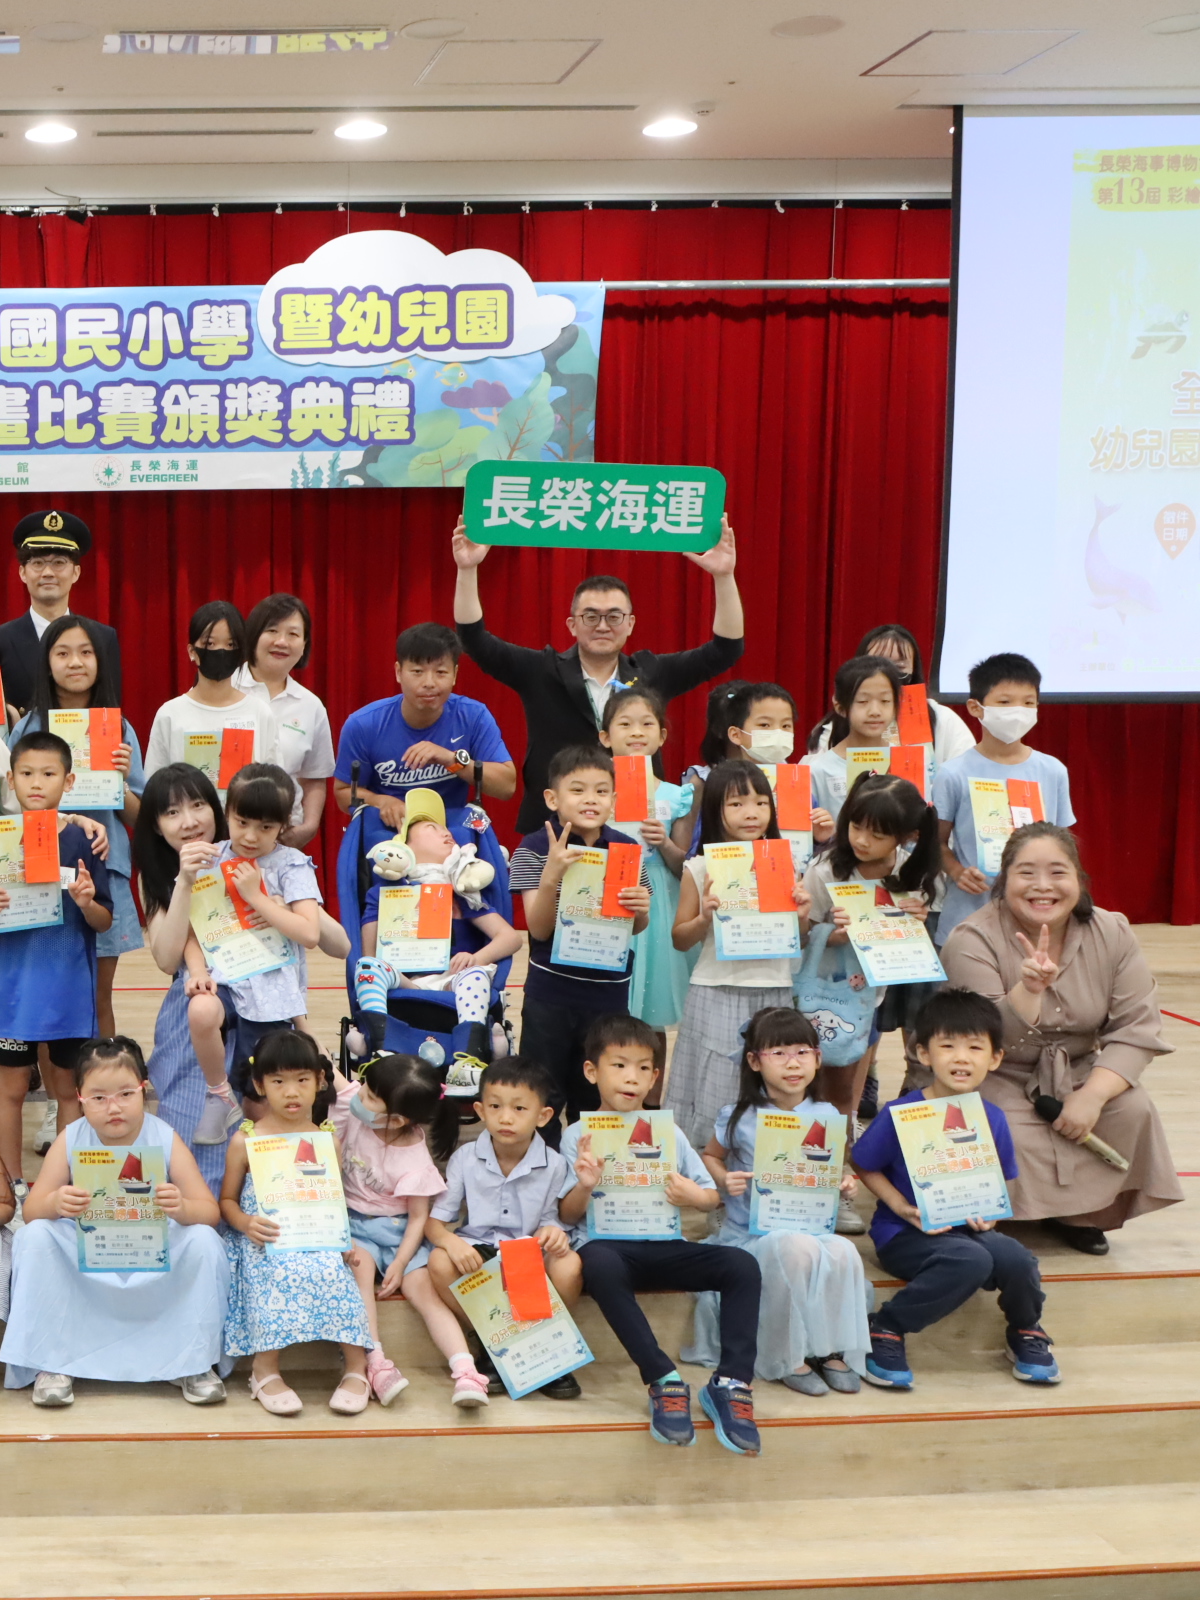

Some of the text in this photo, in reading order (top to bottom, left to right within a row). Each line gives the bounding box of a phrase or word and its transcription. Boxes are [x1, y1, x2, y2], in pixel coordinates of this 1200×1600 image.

[275, 283, 513, 355] 暨幼兒園
[130, 459, 199, 473] 長榮海運
[130, 474, 199, 483] EVERGREEN
[483, 476, 706, 535] 長榮海運
[1162, 527, 1189, 542] 日期
